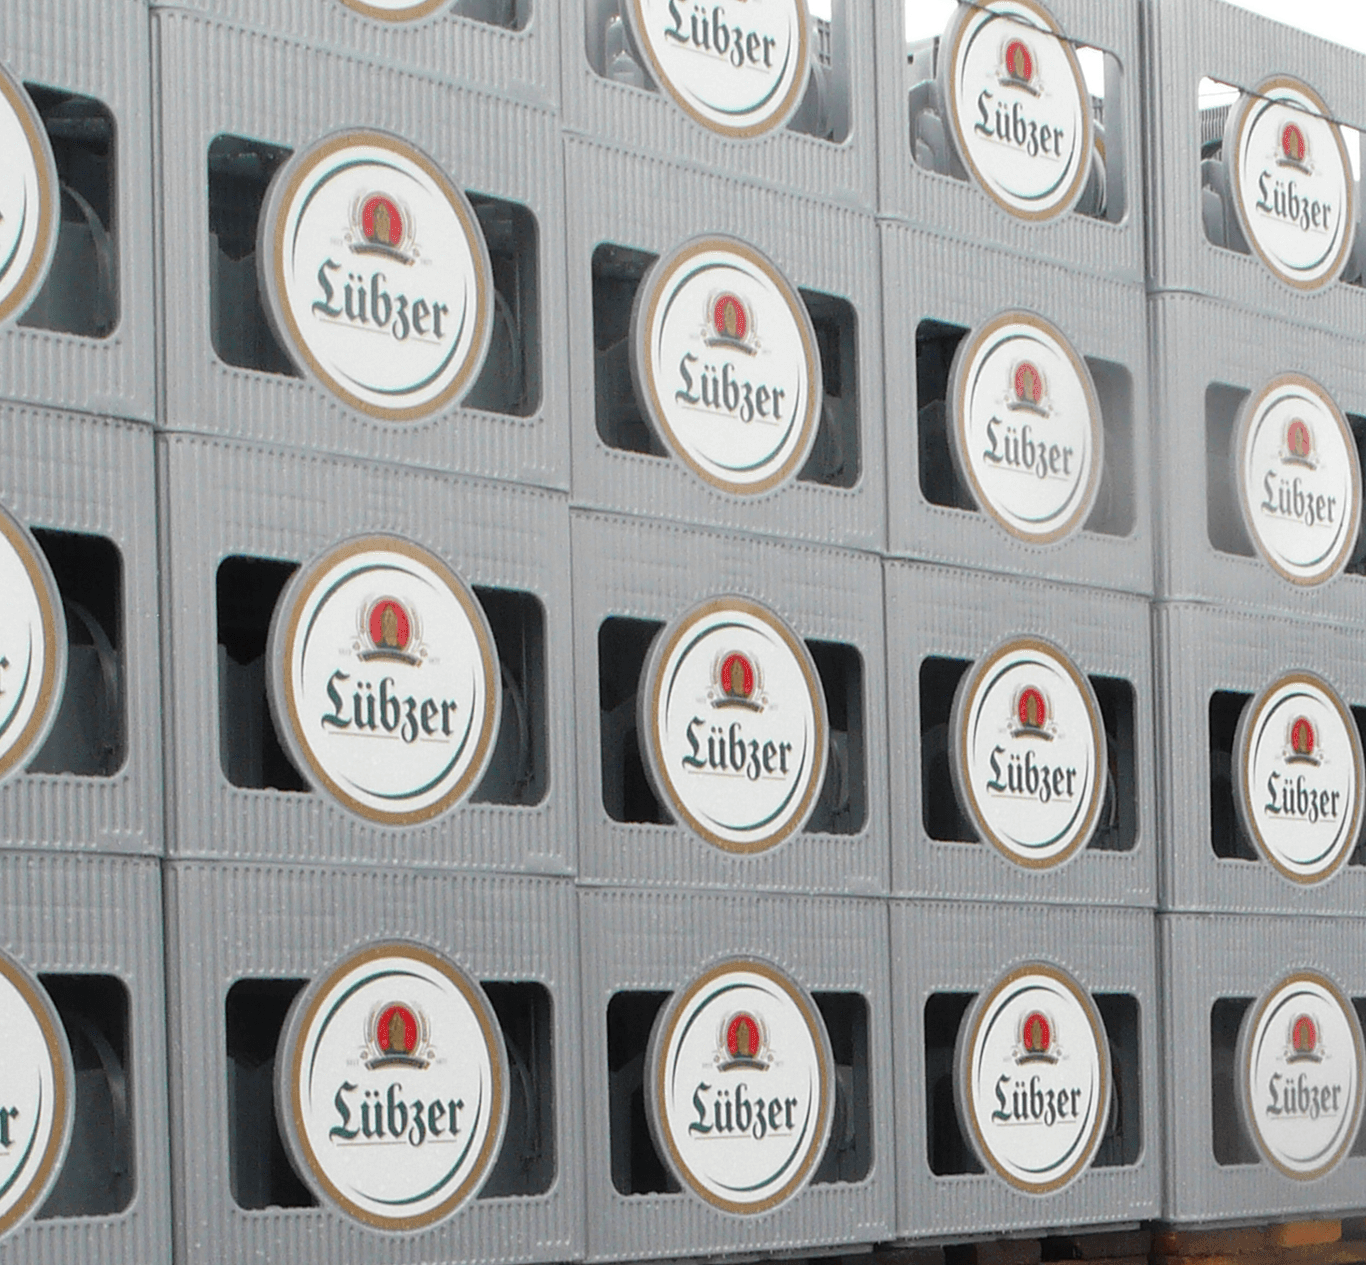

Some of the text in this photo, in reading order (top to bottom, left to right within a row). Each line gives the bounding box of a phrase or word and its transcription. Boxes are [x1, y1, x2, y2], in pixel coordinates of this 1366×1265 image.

[664, 0, 776, 68] Lübzer
[974, 89, 1064, 158] Lübzer
[1256, 170, 1331, 232] Lübzer
[311, 258, 449, 341] Lübzer
[675, 352, 785, 423] Lübzer
[983, 415, 1073, 479] Lübzer
[1261, 469, 1336, 527] Lübzer
[321, 669, 457, 743] Lübzer
[682, 716, 792, 781] Lübzer
[986, 745, 1077, 803] Lübzer
[1264, 770, 1340, 824] Lübzer
[329, 1081, 464, 1147] Lübzer
[688, 1081, 798, 1140] Lübzer
[991, 1074, 1081, 1126] Lübzer
[1266, 1072, 1342, 1120] Lübzer
